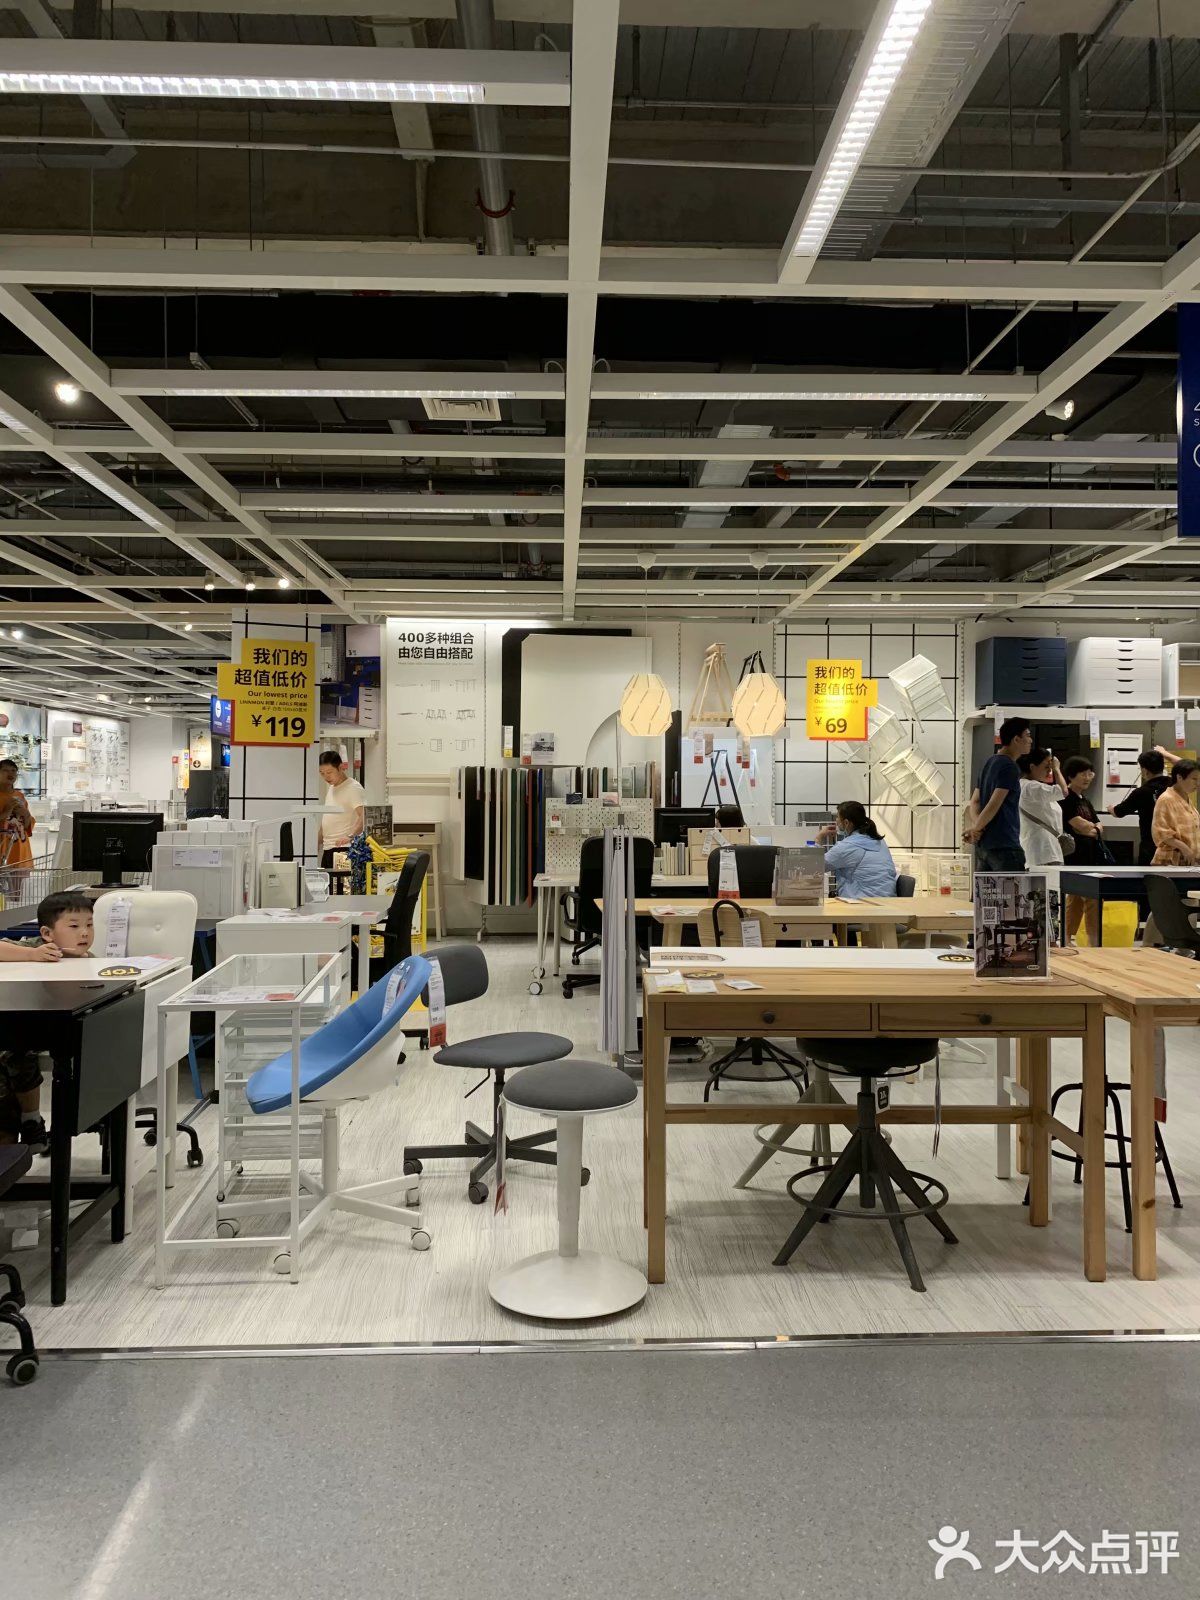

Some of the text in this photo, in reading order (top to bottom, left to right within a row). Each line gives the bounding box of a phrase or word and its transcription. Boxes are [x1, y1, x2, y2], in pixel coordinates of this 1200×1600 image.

[398, 632, 474, 644] 400多种组合
[253, 647, 308, 667] 我们的
[398, 646, 473, 659] 由您自由搭配
[234, 668, 308, 689] 超值低价
[814, 666, 855, 679] 我们的
[264, 690, 288, 698] lowest
[814, 683, 868, 696] 超值低价
